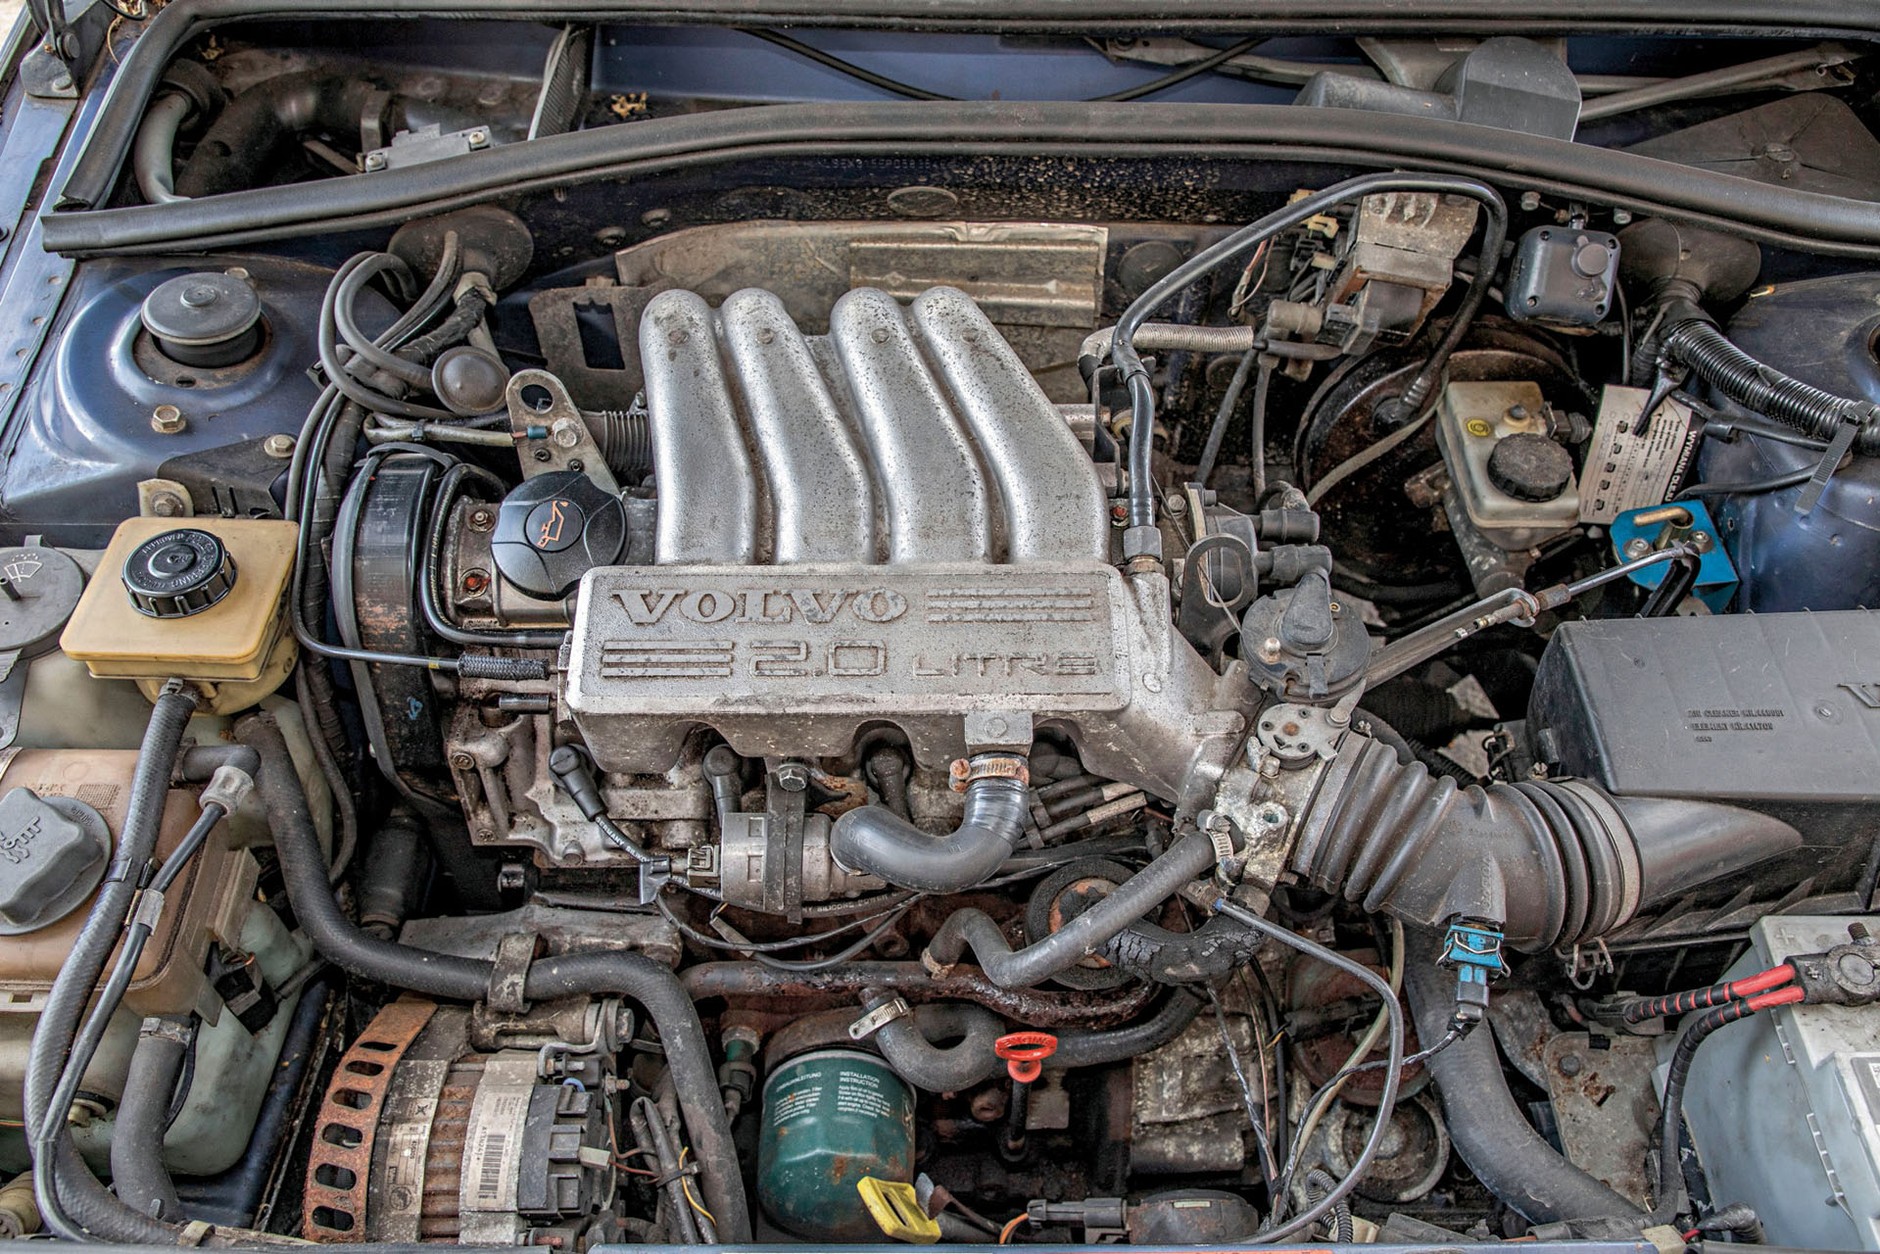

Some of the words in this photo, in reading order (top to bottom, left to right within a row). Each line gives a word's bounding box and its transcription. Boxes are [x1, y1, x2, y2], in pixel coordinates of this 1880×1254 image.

[1674, 430, 1698, 474] WYMIANA
[611, 587, 909, 625] VOLVO
[748, 638, 888, 679] 2.0
[911, 652, 1097, 679] LITRE
[595, 815, 624, 847] GERMANY
